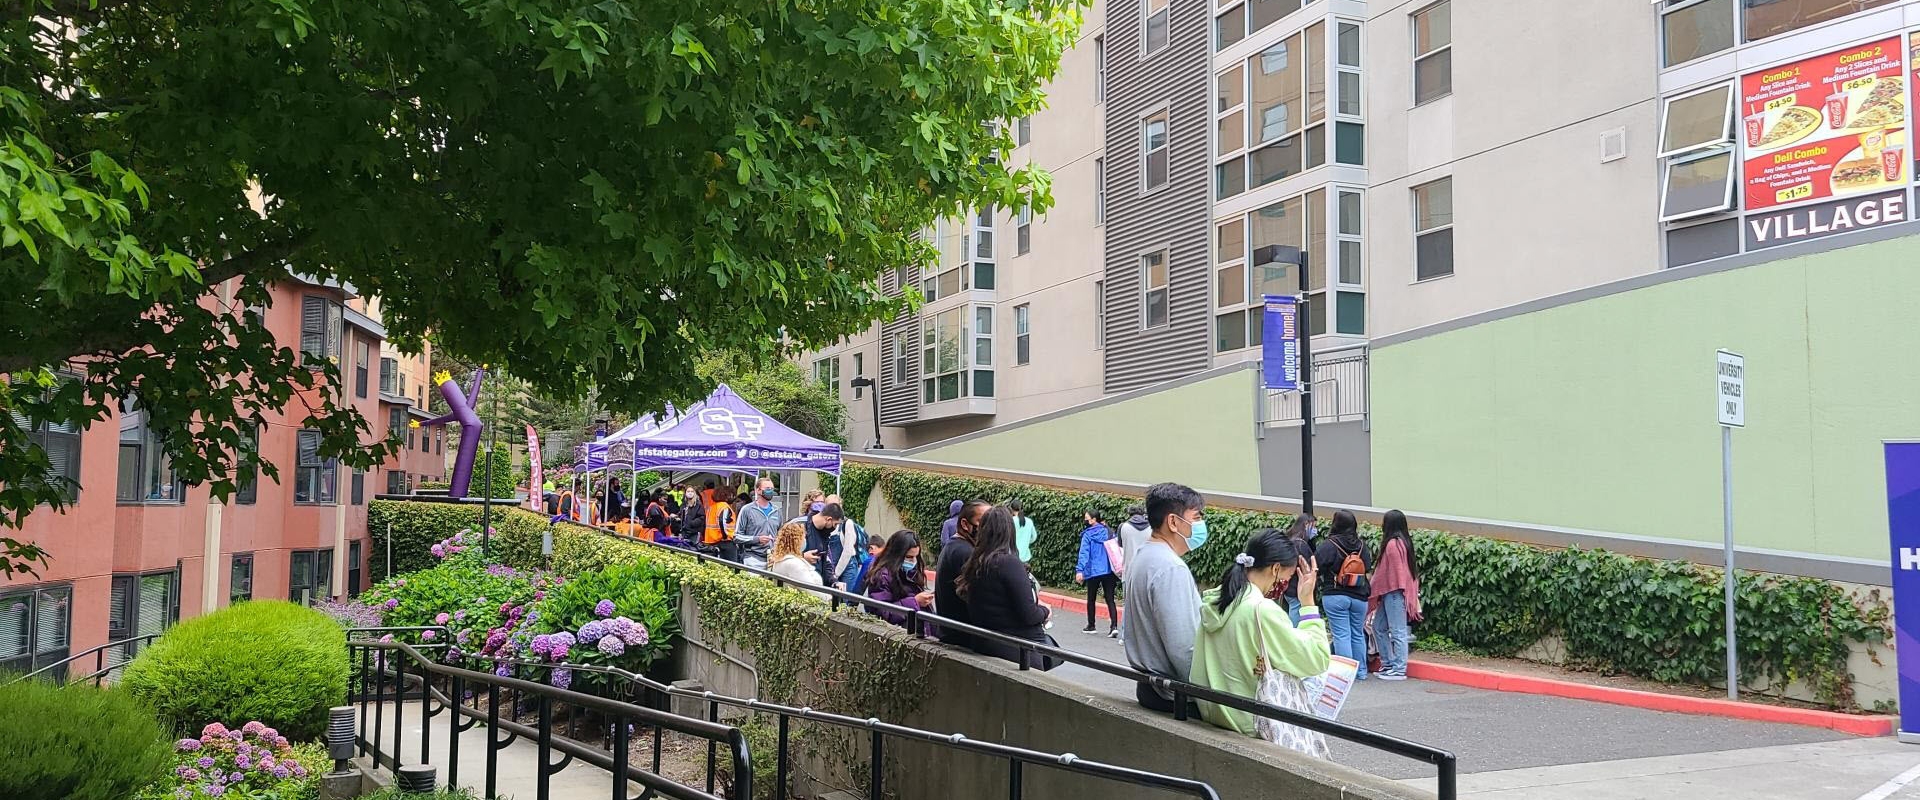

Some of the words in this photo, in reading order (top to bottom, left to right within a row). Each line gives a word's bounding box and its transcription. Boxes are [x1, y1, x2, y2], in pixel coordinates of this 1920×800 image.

[1840, 50, 1873, 64] Combo
[1874, 46, 1881, 56] 2
[1822, 73, 1849, 84] Medium
[1850, 65, 1880, 77] Fountain
[1881, 60, 1901, 70] Drink
[1834, 66, 1848, 75] Any
[1853, 60, 1873, 69] Slices
[1874, 55, 1888, 64] and
[1762, 70, 1793, 84] Combo
[1794, 66, 1801, 76] 1
[1745, 92, 1769, 103] Medium
[1769, 85, 1795, 97] Fountain
[1794, 81, 1812, 91] Drink
[1760, 84, 1771, 92] Any
[1771, 80, 1785, 89] Slice
[1786, 77, 1797, 86] and
[1774, 151, 1793, 164] Deli
[1794, 146, 1827, 160] Combo
[1774, 163, 1786, 172] Deli
[1807, 163, 1832, 173] Medium
[1770, 179, 1795, 188] Fountain
[1795, 175, 1811, 183] Drink
[1750, 194, 1904, 242] VILLAGE
[1282, 341, 1295, 381] welcome
[1718, 361, 1743, 379] UNIVERSITY
[1720, 380, 1741, 398] VEHICLES
[1725, 400, 1737, 416] ONLY
[698, 407, 765, 441] SF
[638, 448, 727, 458] sfstategators.com
